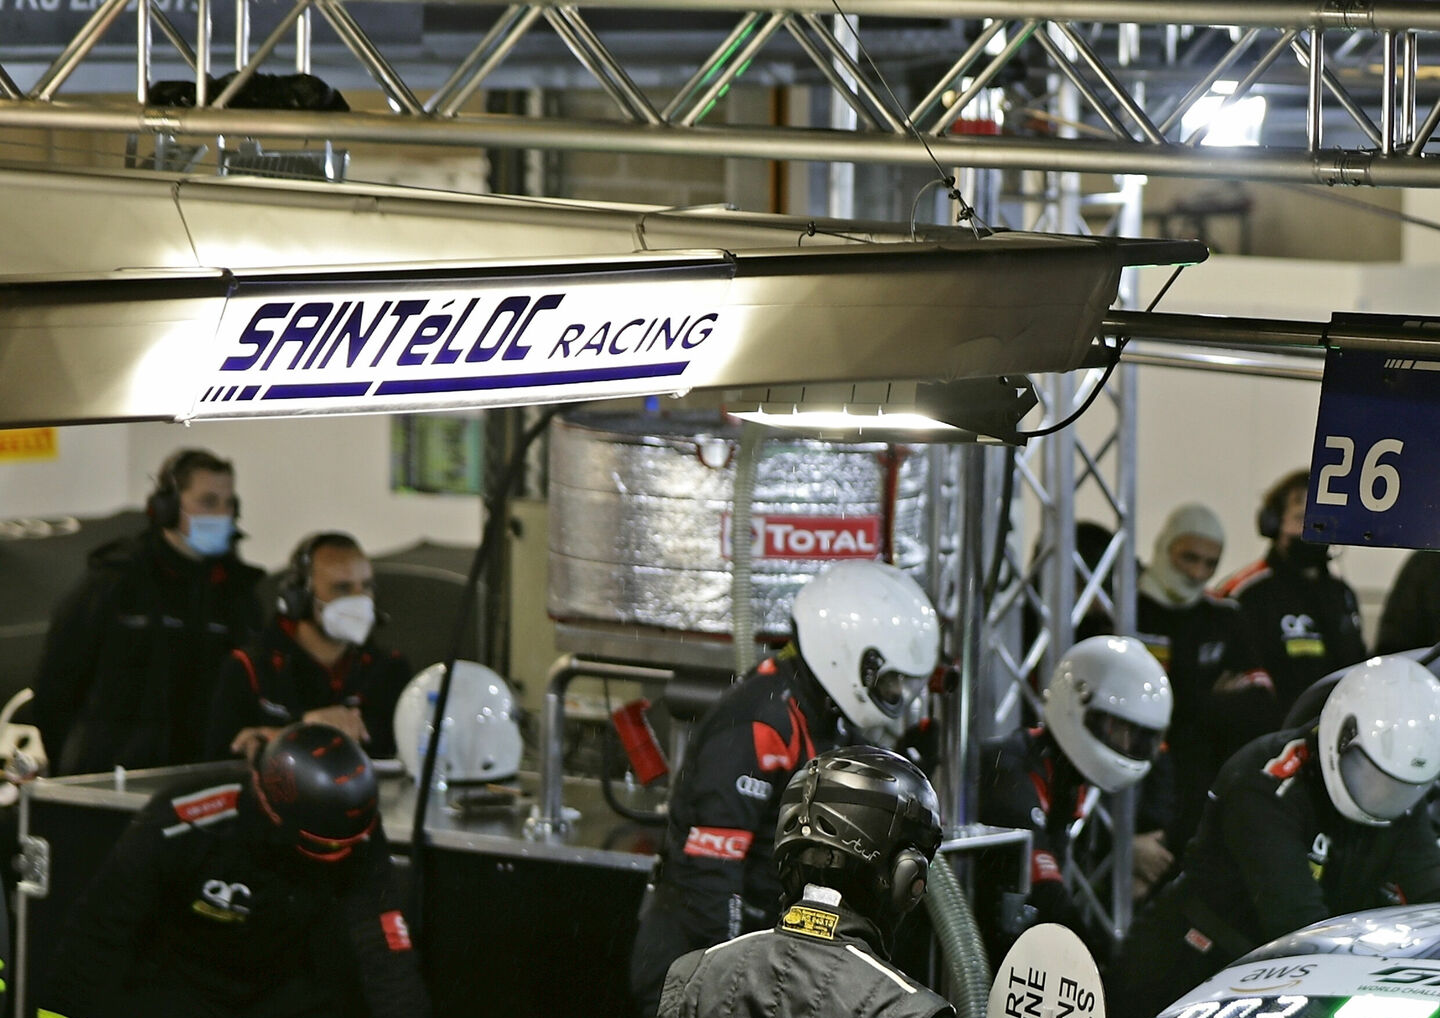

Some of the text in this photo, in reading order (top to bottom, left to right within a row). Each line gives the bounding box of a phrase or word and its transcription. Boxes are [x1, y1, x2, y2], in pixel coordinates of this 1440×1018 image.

[547, 312, 718, 359] RACING
[1316, 435, 1404, 513] 26
[766, 523, 875, 553] TOTAL
[1240, 962, 1319, 985] aws
[1357, 984, 1400, 994] WORLD
